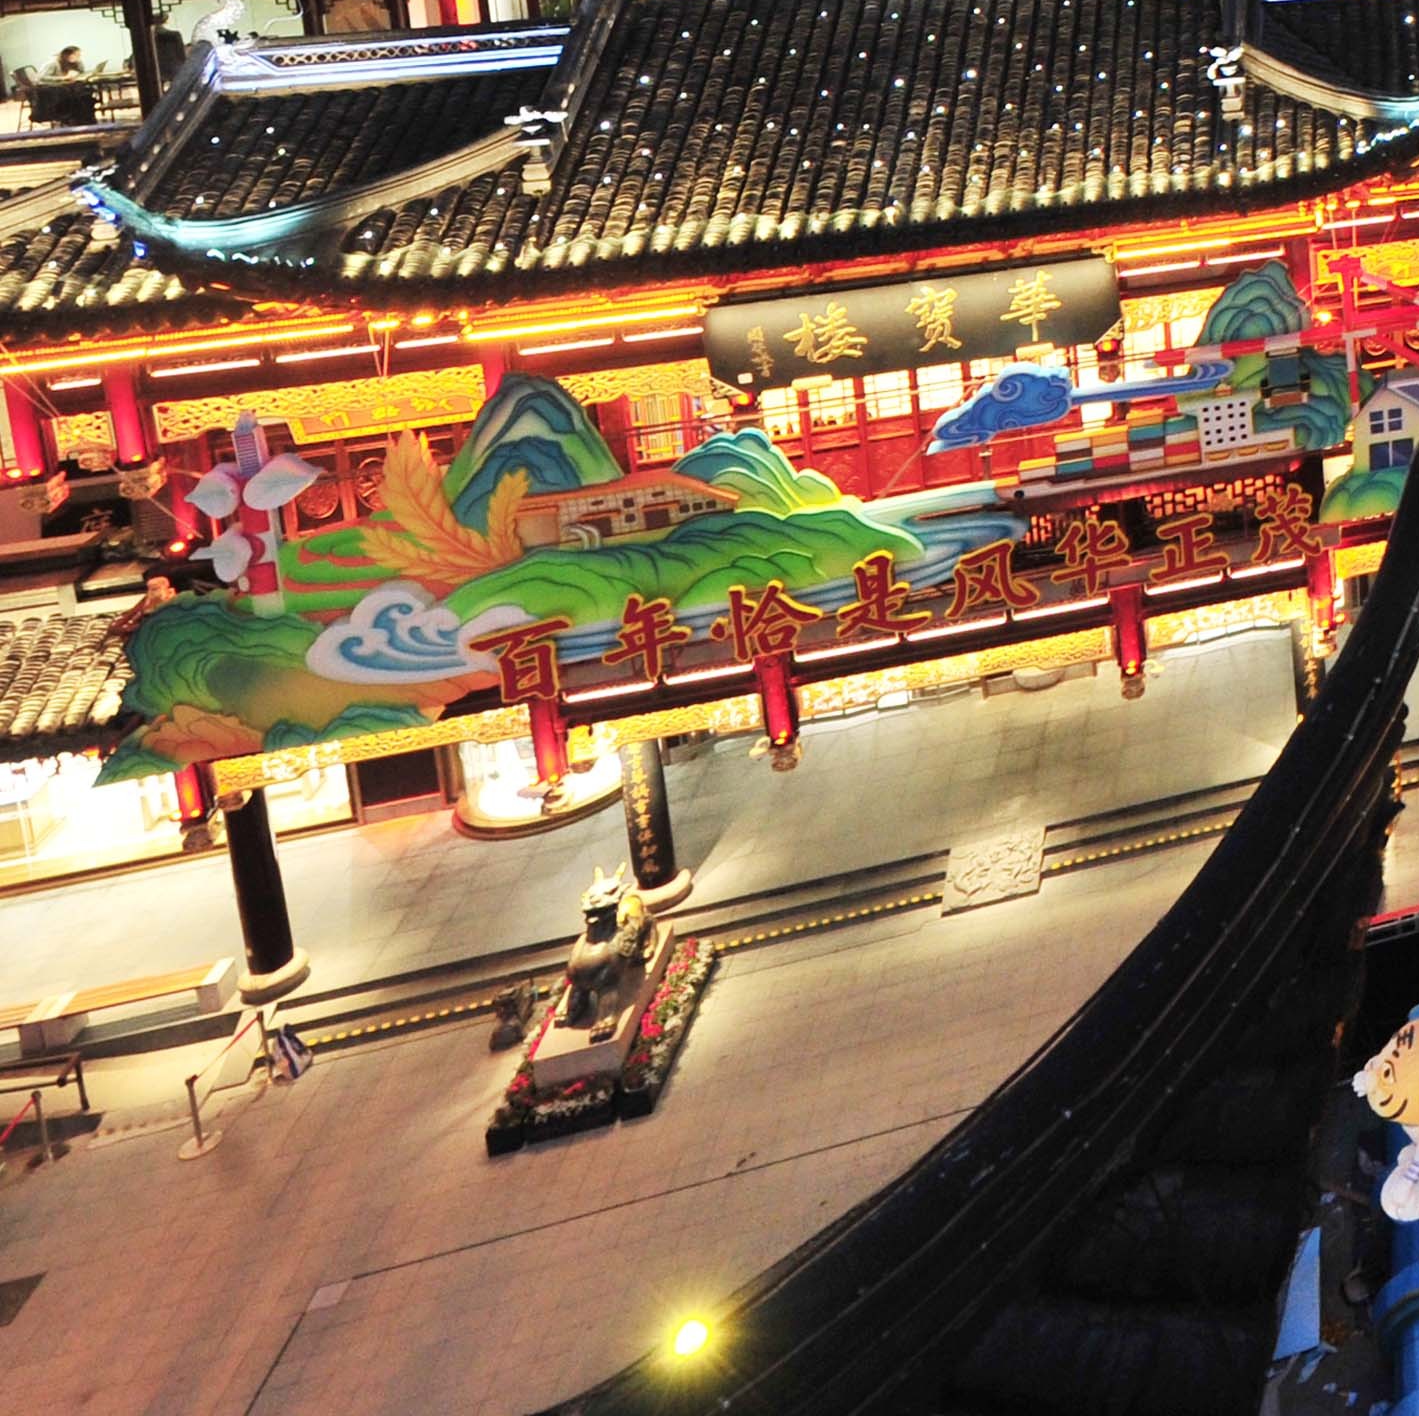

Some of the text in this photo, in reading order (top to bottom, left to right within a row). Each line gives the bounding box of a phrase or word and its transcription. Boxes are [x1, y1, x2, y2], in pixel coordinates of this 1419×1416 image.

[469, 485, 1322, 703] 百年恰是风华正茂
